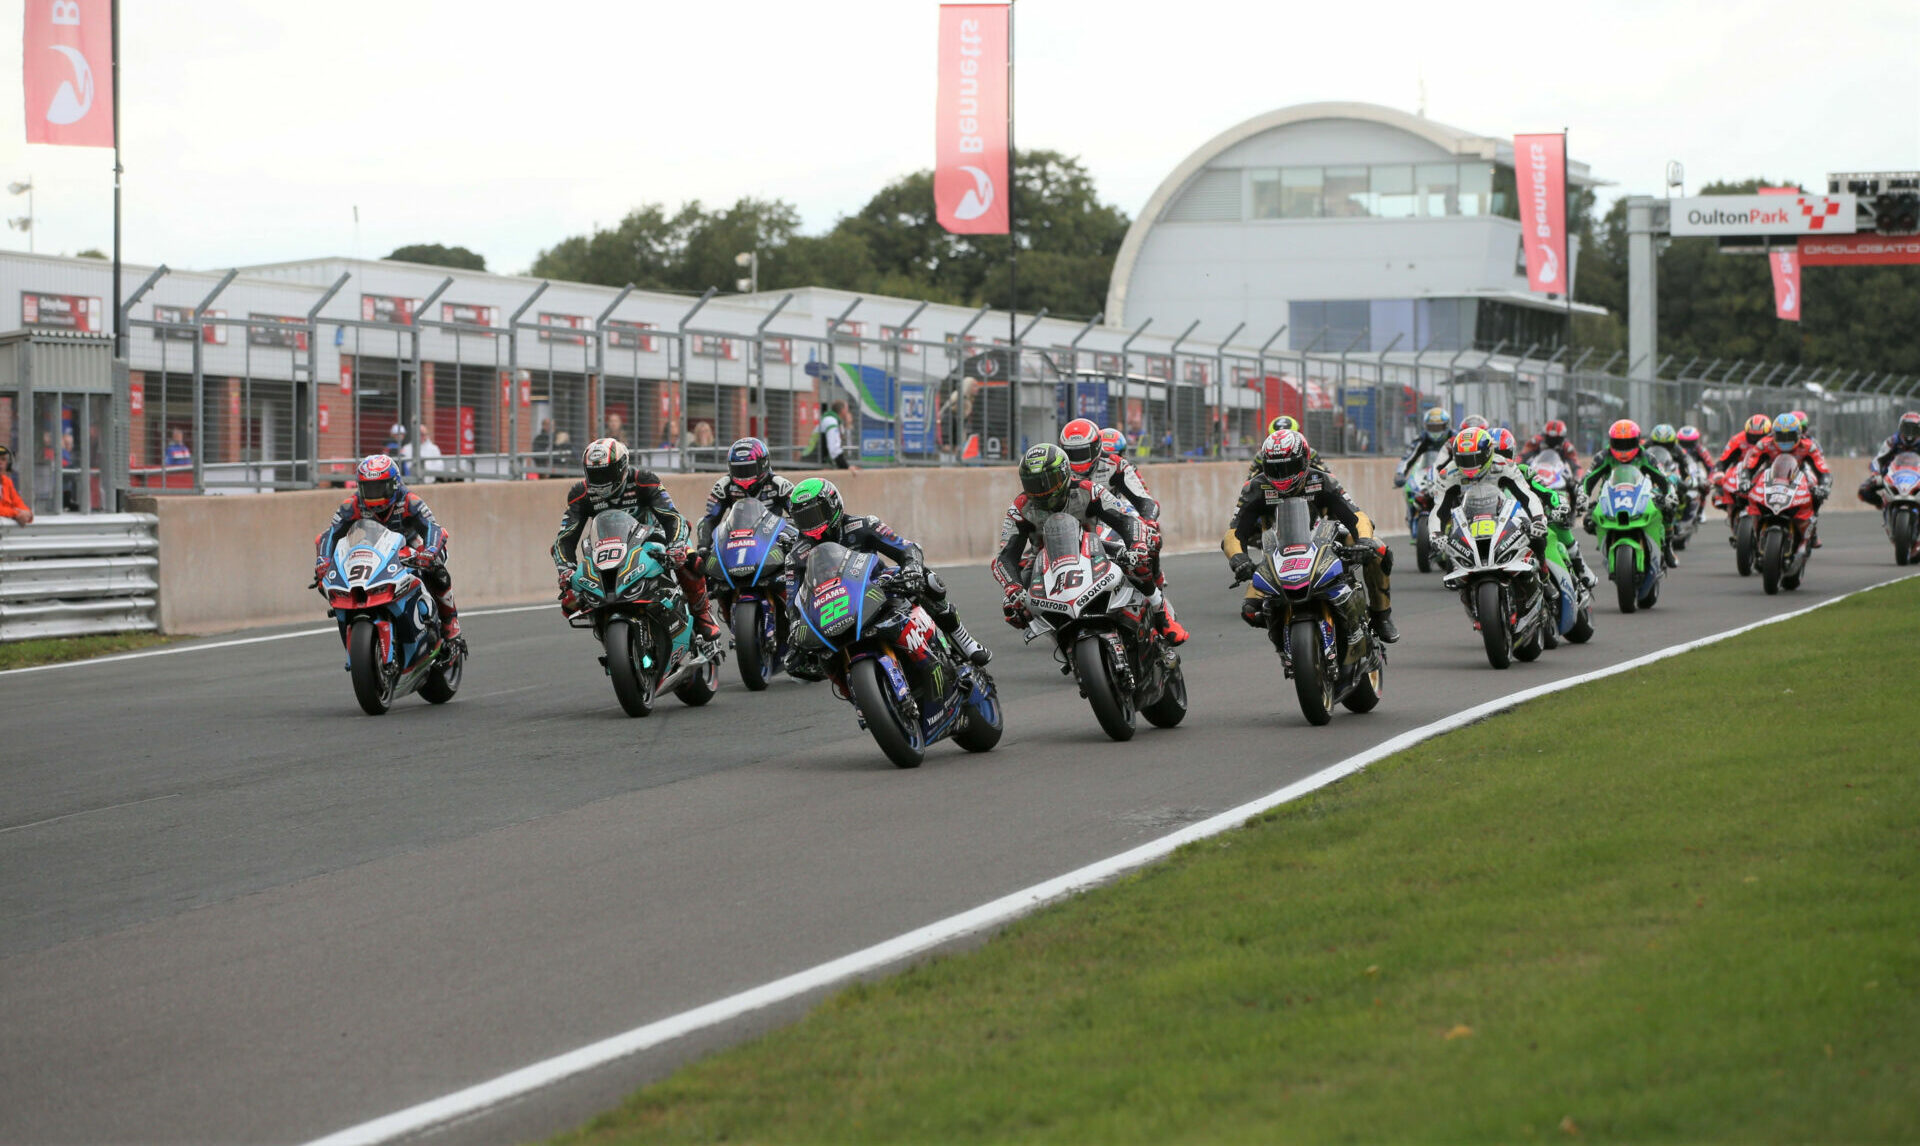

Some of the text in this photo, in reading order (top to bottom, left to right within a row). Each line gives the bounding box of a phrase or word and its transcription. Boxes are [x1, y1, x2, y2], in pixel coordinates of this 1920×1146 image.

[1688, 208, 1789, 225] OultonPark
[1614, 496, 1633, 509] 14
[1470, 520, 1496, 538] 18
[727, 540, 756, 549] McAMS
[597, 549, 622, 563] 60
[736, 547, 748, 565] 1
[348, 565, 373, 582] 91
[1279, 558, 1312, 573] 28
[1049, 569, 1085, 596] 46
[1088, 573, 1115, 597] OXFORD
[813, 587, 847, 609] McAMS
[1040, 601, 1068, 611] OXFORD
[820, 595, 850, 628] 22
